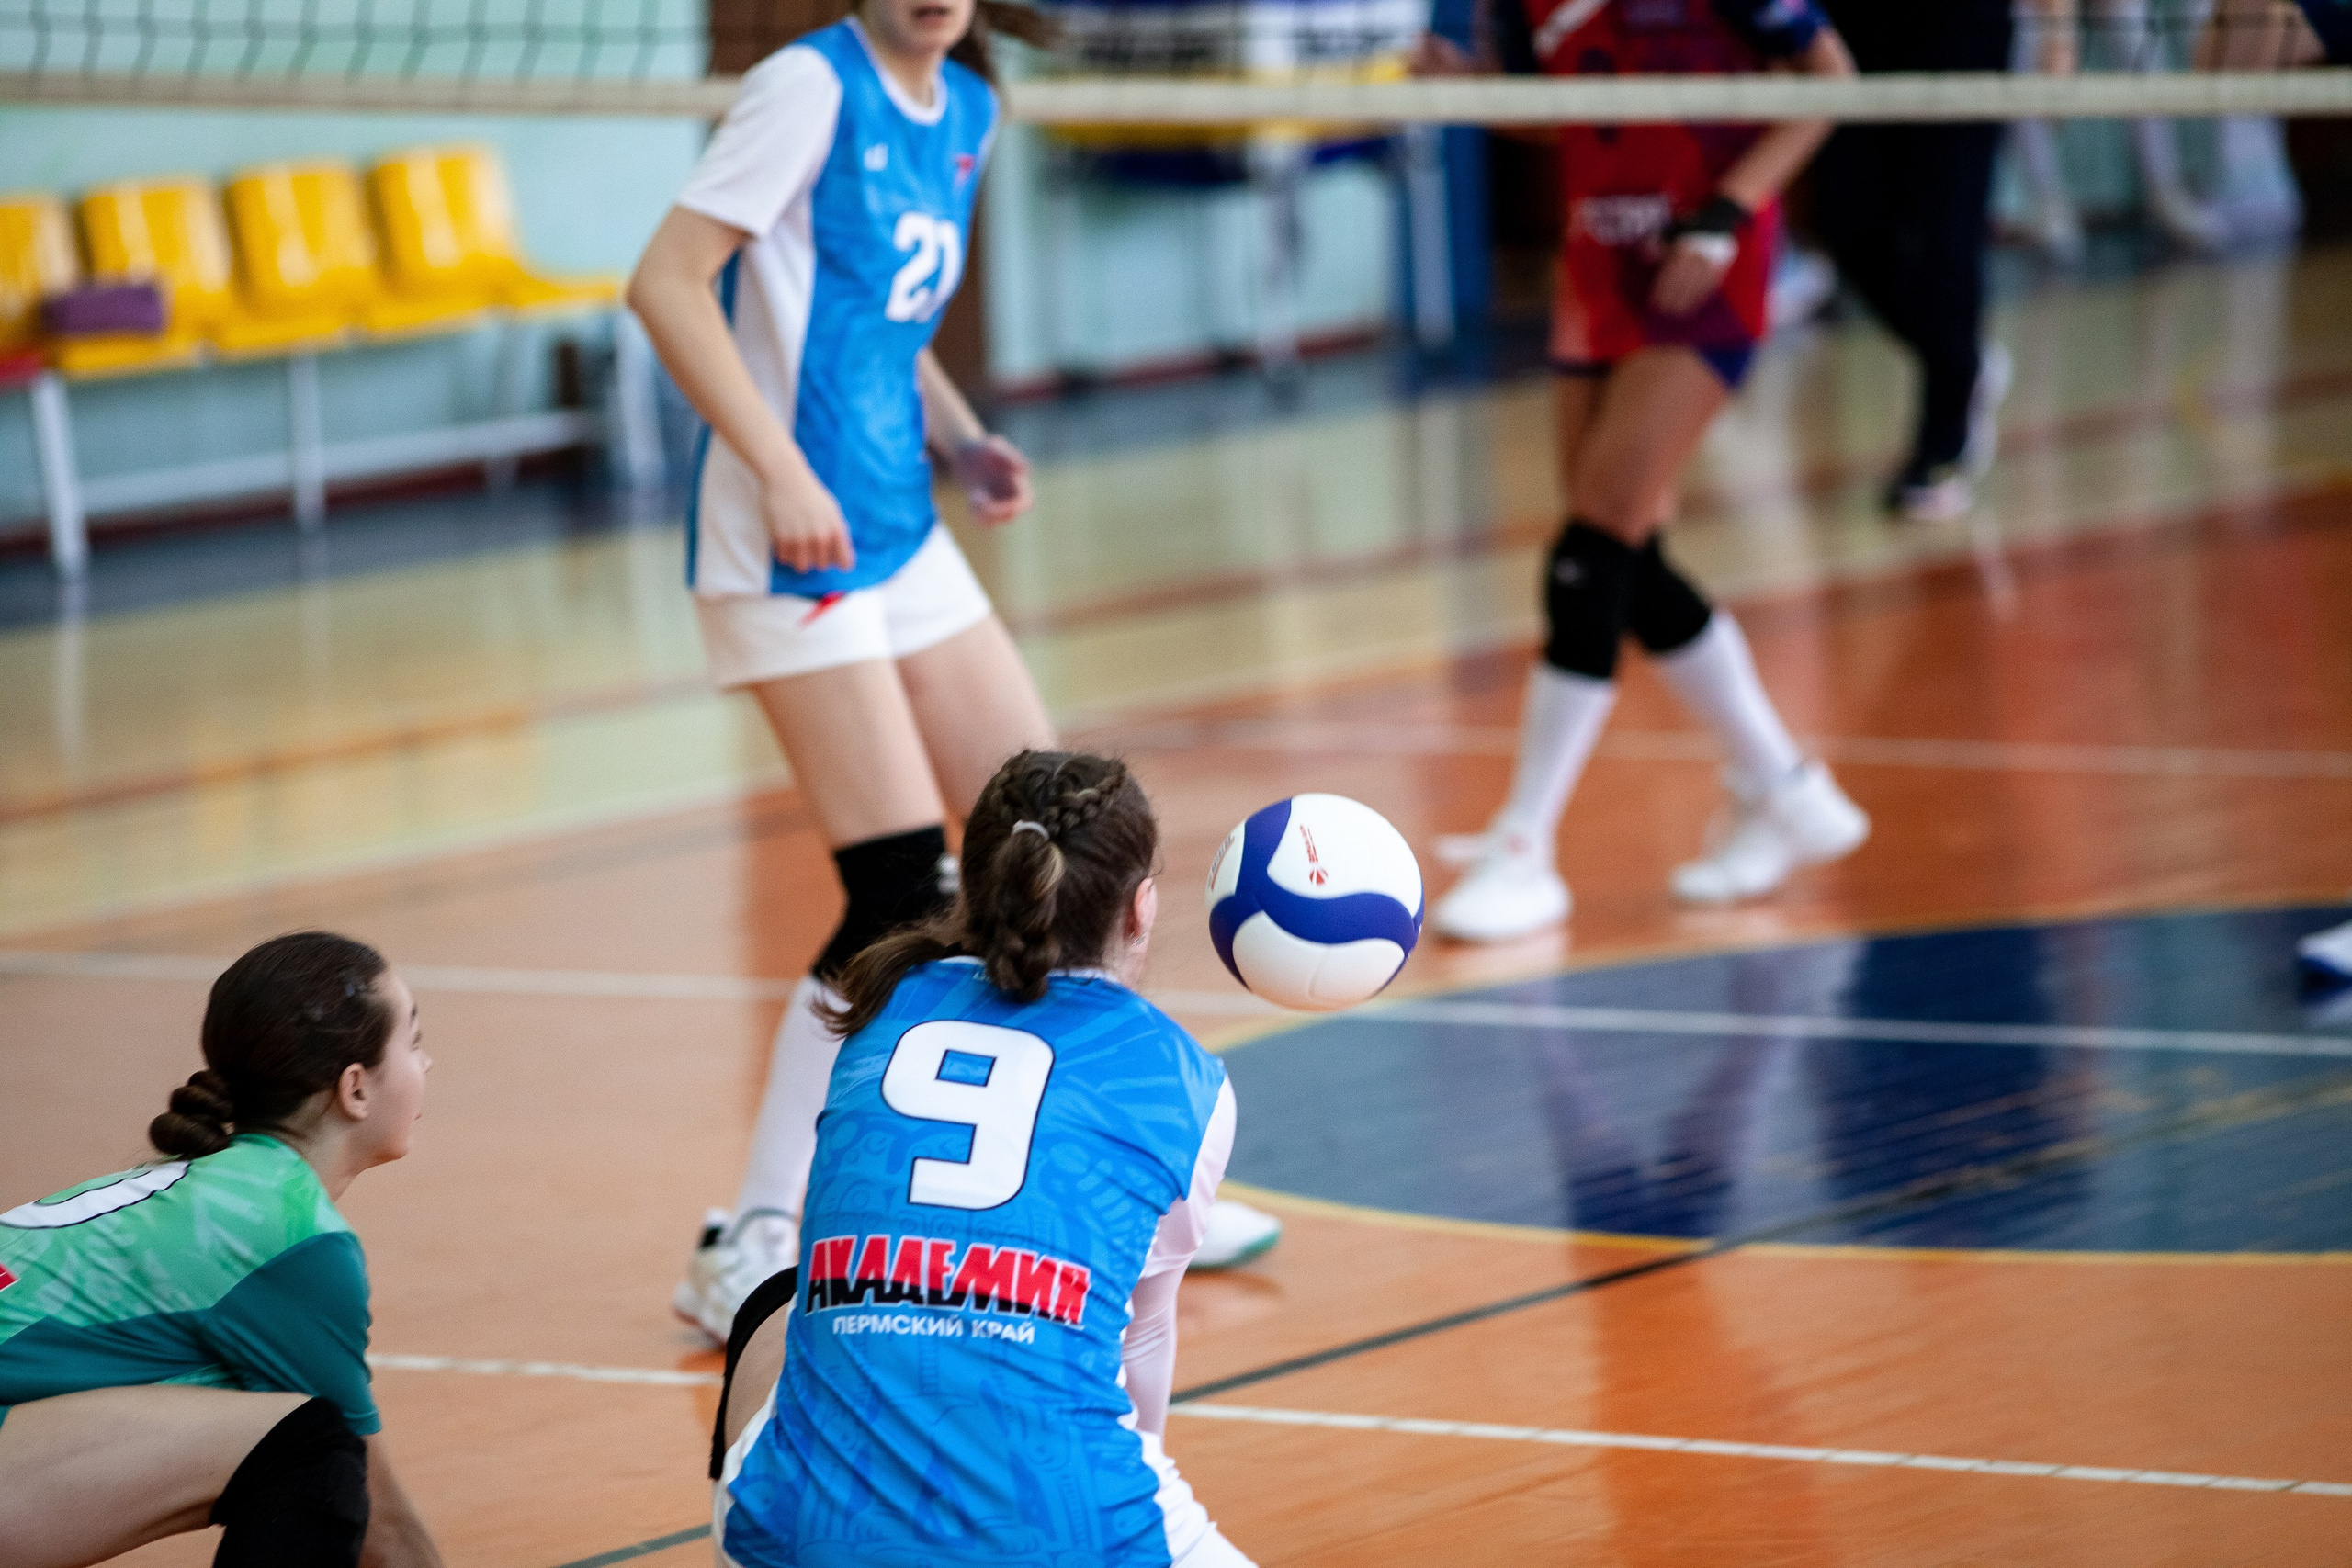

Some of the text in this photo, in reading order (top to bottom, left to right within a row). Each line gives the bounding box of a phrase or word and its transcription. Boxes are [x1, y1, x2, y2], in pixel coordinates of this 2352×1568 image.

[886, 212, 962, 321] 21
[882, 1020, 1054, 1210] 9
[806, 1234, 1091, 1330] АКАДЕМИЯ
[832, 1314, 1035, 1344] ПЕРМСКИЙ КРАЙ
